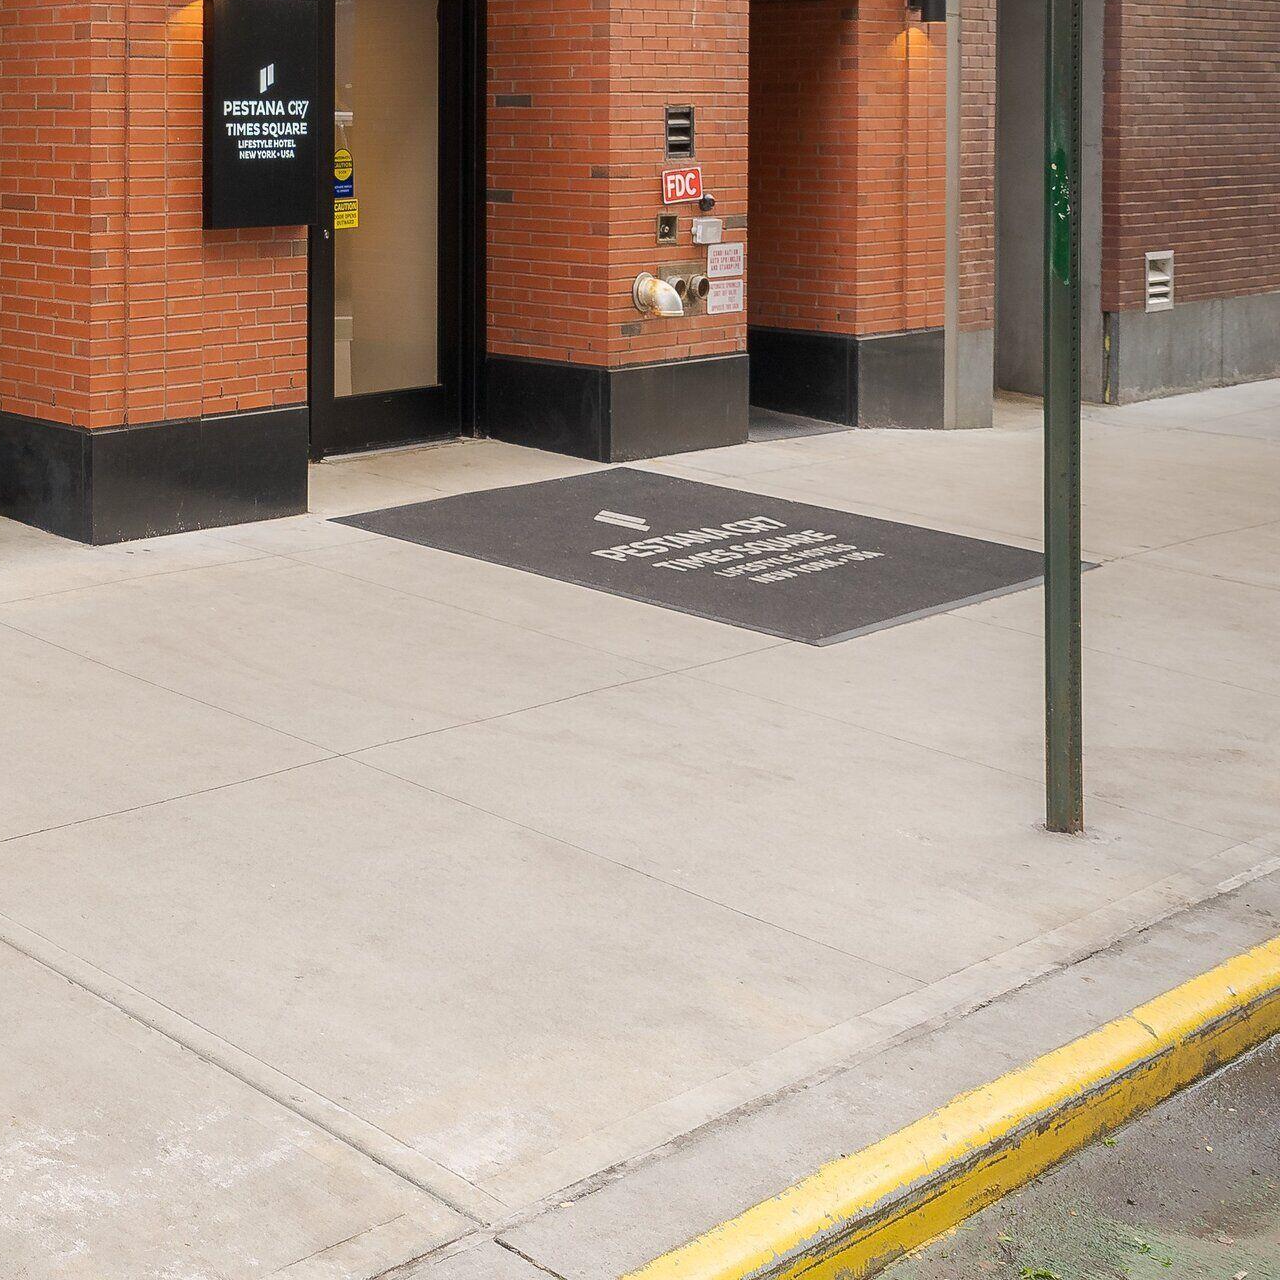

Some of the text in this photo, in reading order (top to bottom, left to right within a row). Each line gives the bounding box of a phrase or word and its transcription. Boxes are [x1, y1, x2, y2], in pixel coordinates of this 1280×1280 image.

[223, 100, 309, 119] PESTANA CR7
[226, 122, 308, 138] TIMES SQUARE
[238, 139, 297, 149] LIFESTYLE HOTEL
[239, 149, 295, 160] NEW YORK USA
[666, 172, 697, 198] FDC
[590, 515, 787, 562] PESTANA CR7
[651, 529, 838, 572] TIMES SQUARE
